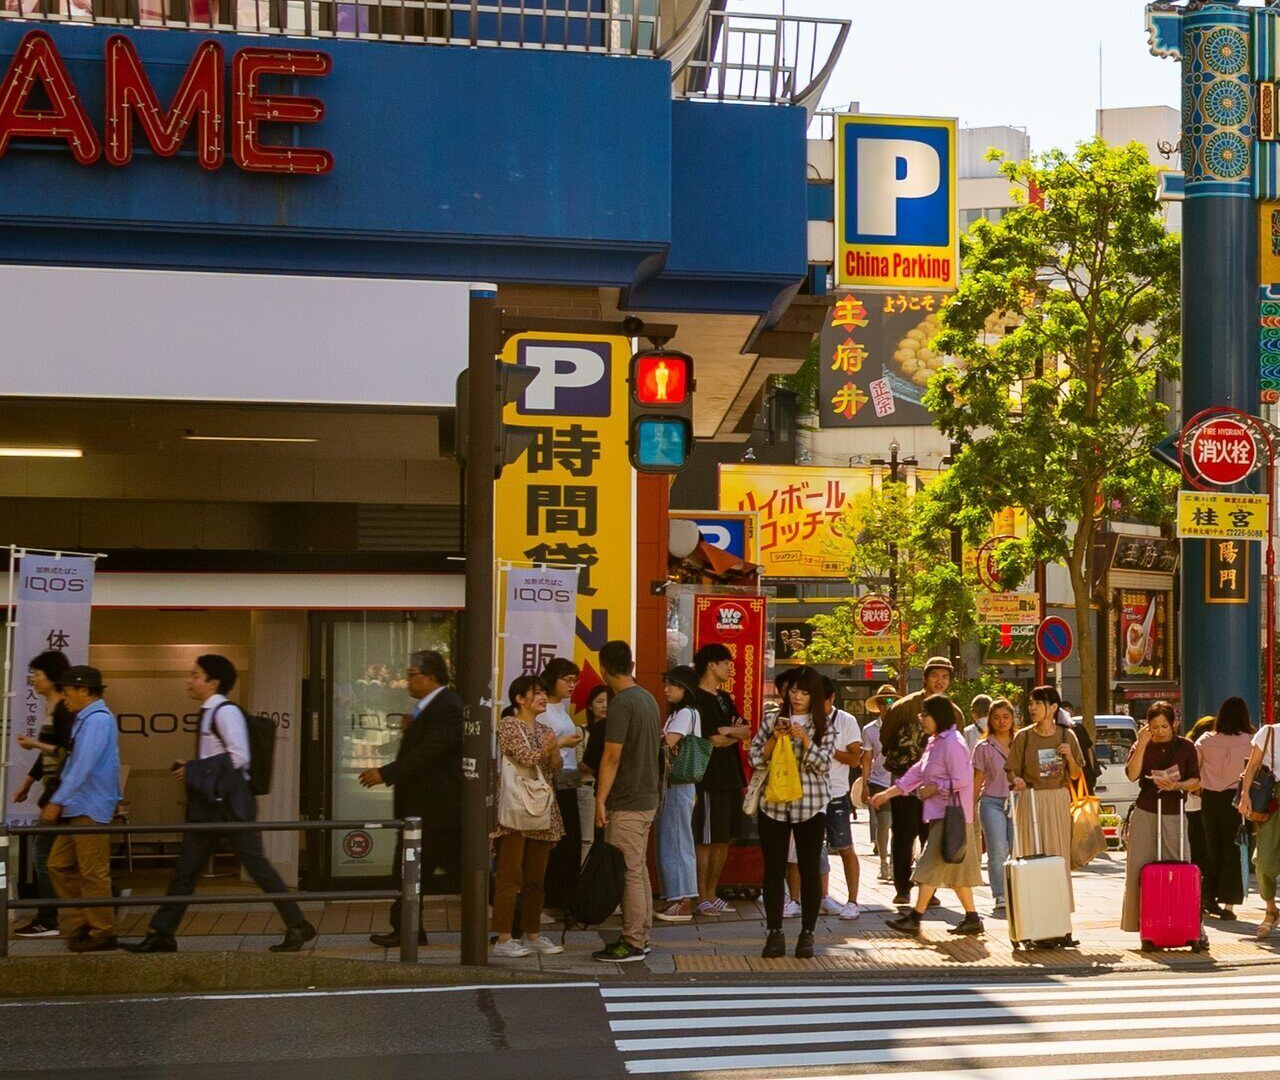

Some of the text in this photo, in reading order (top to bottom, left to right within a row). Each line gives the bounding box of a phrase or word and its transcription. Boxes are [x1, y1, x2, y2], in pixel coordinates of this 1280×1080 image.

[857, 138, 940, 237] P
[845, 250, 950, 283] China Parking
[883, 295, 936, 313] ようこそ
[831, 299, 869, 415] 王府井
[525, 346, 605, 410] P
[1198, 439, 1250, 465] 消火栓
[1191, 507, 1254, 528] 桂宮
[1219, 541, 1239, 591] 陽門
[24, 576, 85, 593] IQOS
[514, 587, 570, 603] IQOS
[862, 609, 890, 623] 消火栓
